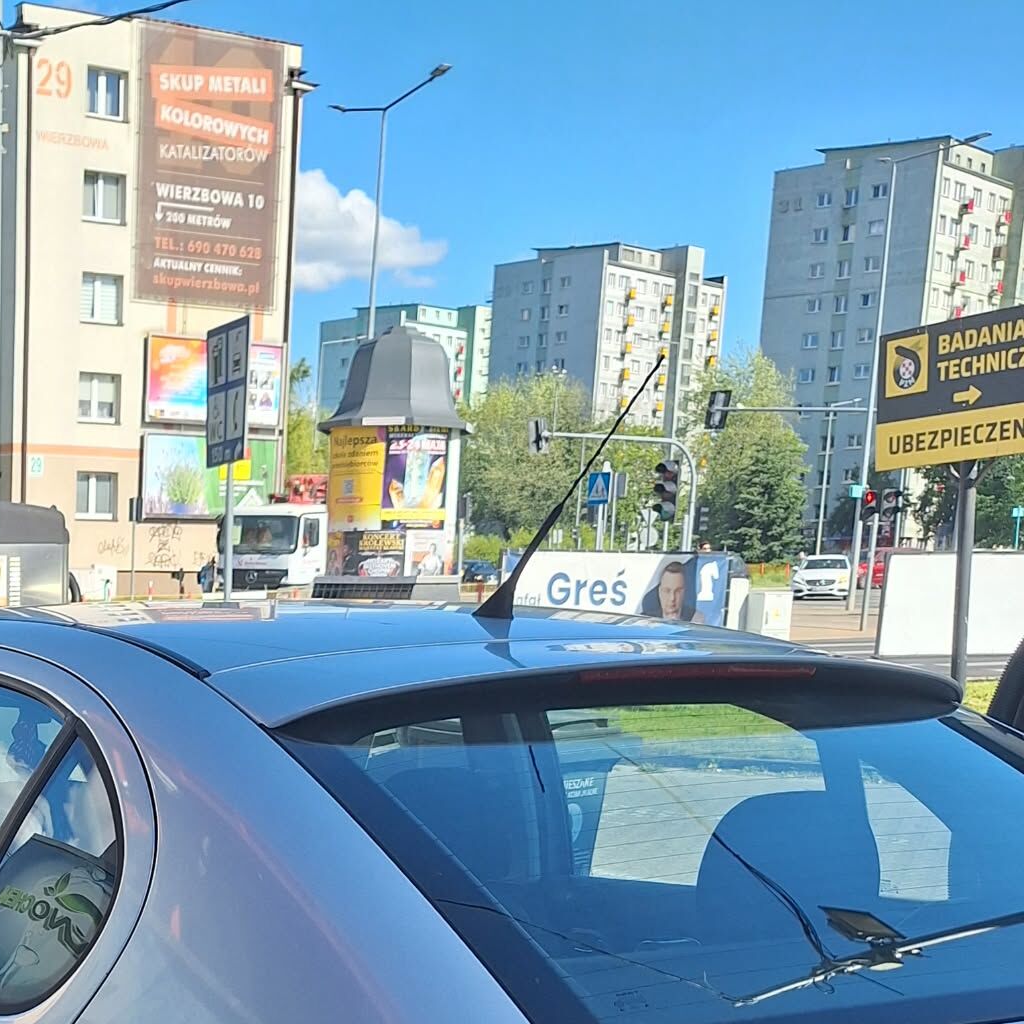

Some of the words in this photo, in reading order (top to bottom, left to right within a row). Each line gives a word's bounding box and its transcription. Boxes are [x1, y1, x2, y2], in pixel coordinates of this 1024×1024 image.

[36, 58, 72, 98] 29
[159, 73, 204, 92] SKUP
[208, 75, 267, 95] METALI
[160, 104, 270, 145] KOLOROWYCH
[36, 130, 109, 150] WIERZBOWA
[159, 142, 269, 163] KATALIZATORÓW
[155, 182, 244, 208] WIERZBOWA
[247, 193, 265, 210] 10
[186, 214, 232, 230] METRÓW
[187, 240, 211, 254] 690
[213, 243, 237, 257] 470
[153, 257, 203, 272] AKTUALNY
[153, 272, 261, 296] skupwierzbowa.pl
[937, 319, 1024, 355] BADANIA
[888, 419, 1024, 455] UBEZPIECZEN
[547, 568, 628, 607] Greś
[516, 593, 542, 606] afał
